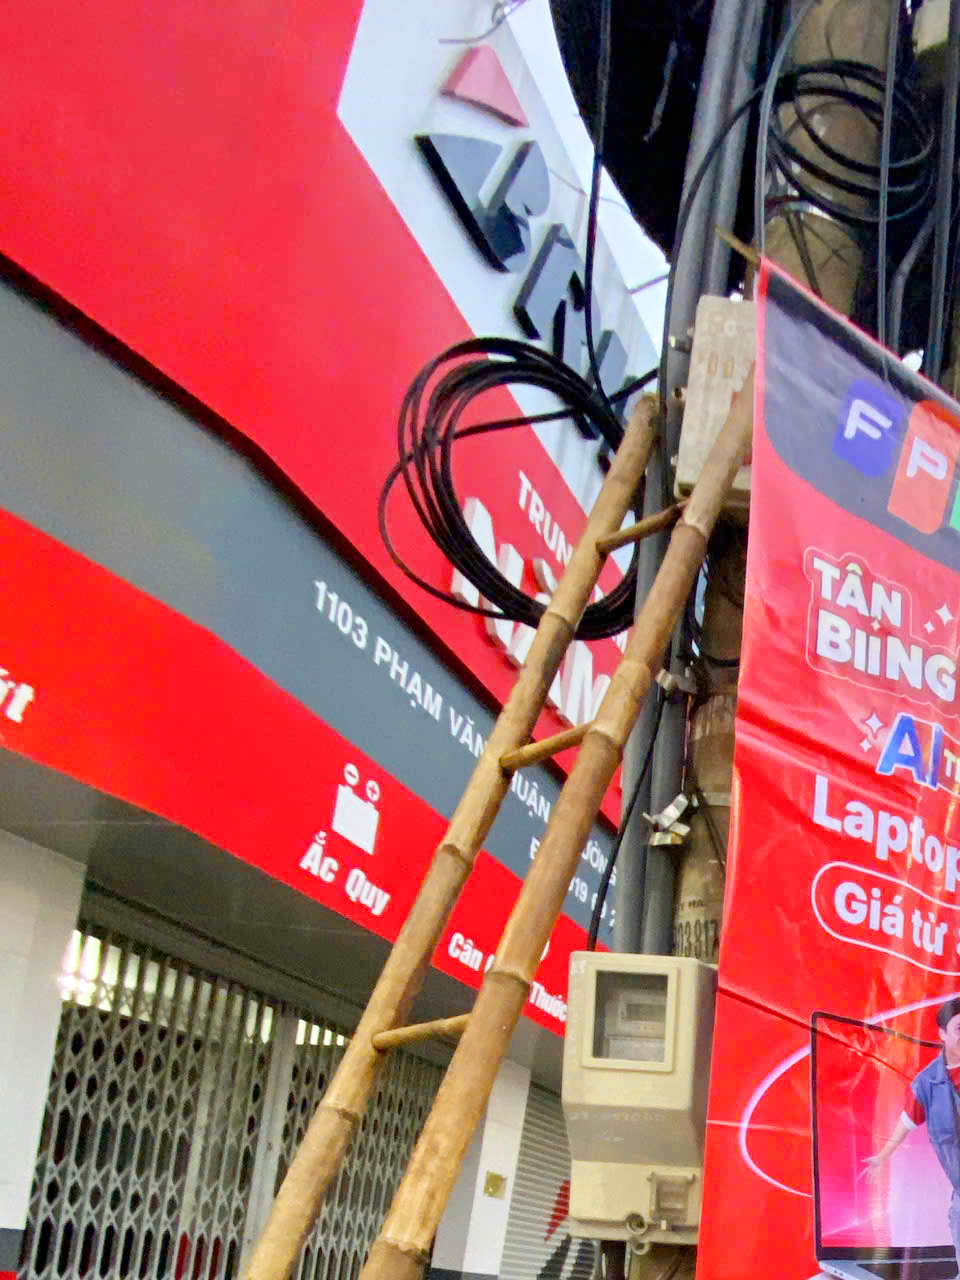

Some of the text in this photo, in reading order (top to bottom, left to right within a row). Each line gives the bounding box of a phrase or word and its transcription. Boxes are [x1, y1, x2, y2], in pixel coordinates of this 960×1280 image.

[517, 470, 573, 566] TRUN
[812, 557, 903, 628] TÂN
[313, 579, 368, 650] 1103
[373, 635, 443, 721] PHẠM
[510, 770, 551, 823] HUẬN
[876, 713, 943, 789] AI
[299, 830, 391, 916] Ắc Quy
[833, 880, 906, 938] Giá
[912, 908, 948, 952] từ
